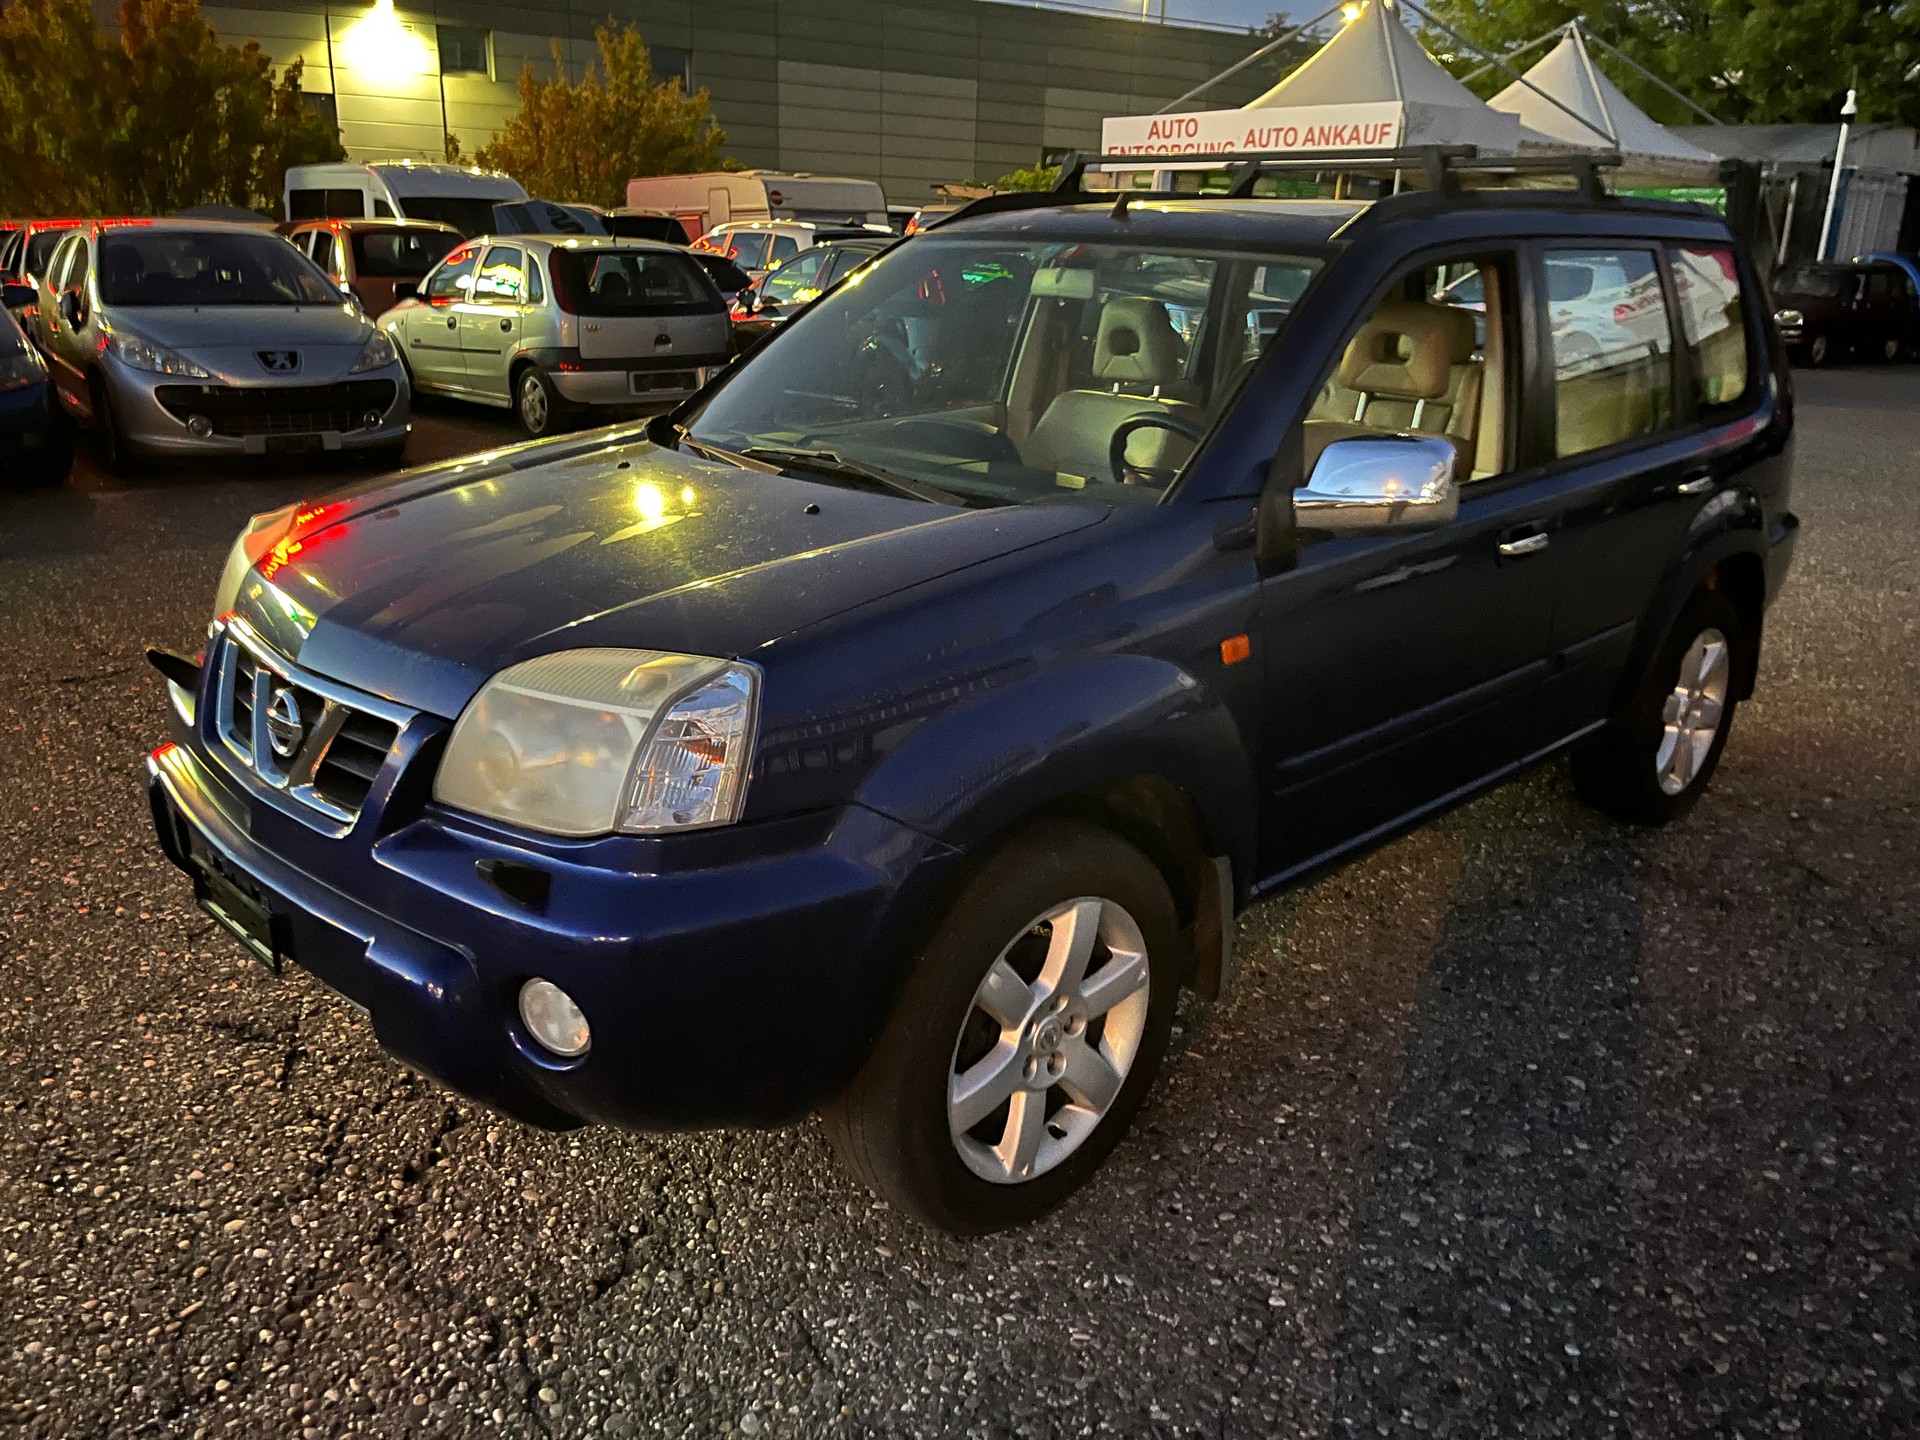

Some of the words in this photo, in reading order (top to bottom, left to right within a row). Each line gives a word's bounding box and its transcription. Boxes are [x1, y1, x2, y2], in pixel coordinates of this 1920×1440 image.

[1147, 118, 1199, 140] AUTO
[1243, 126, 1299, 148] AUTO
[1301, 123, 1393, 147] ANKAUF
